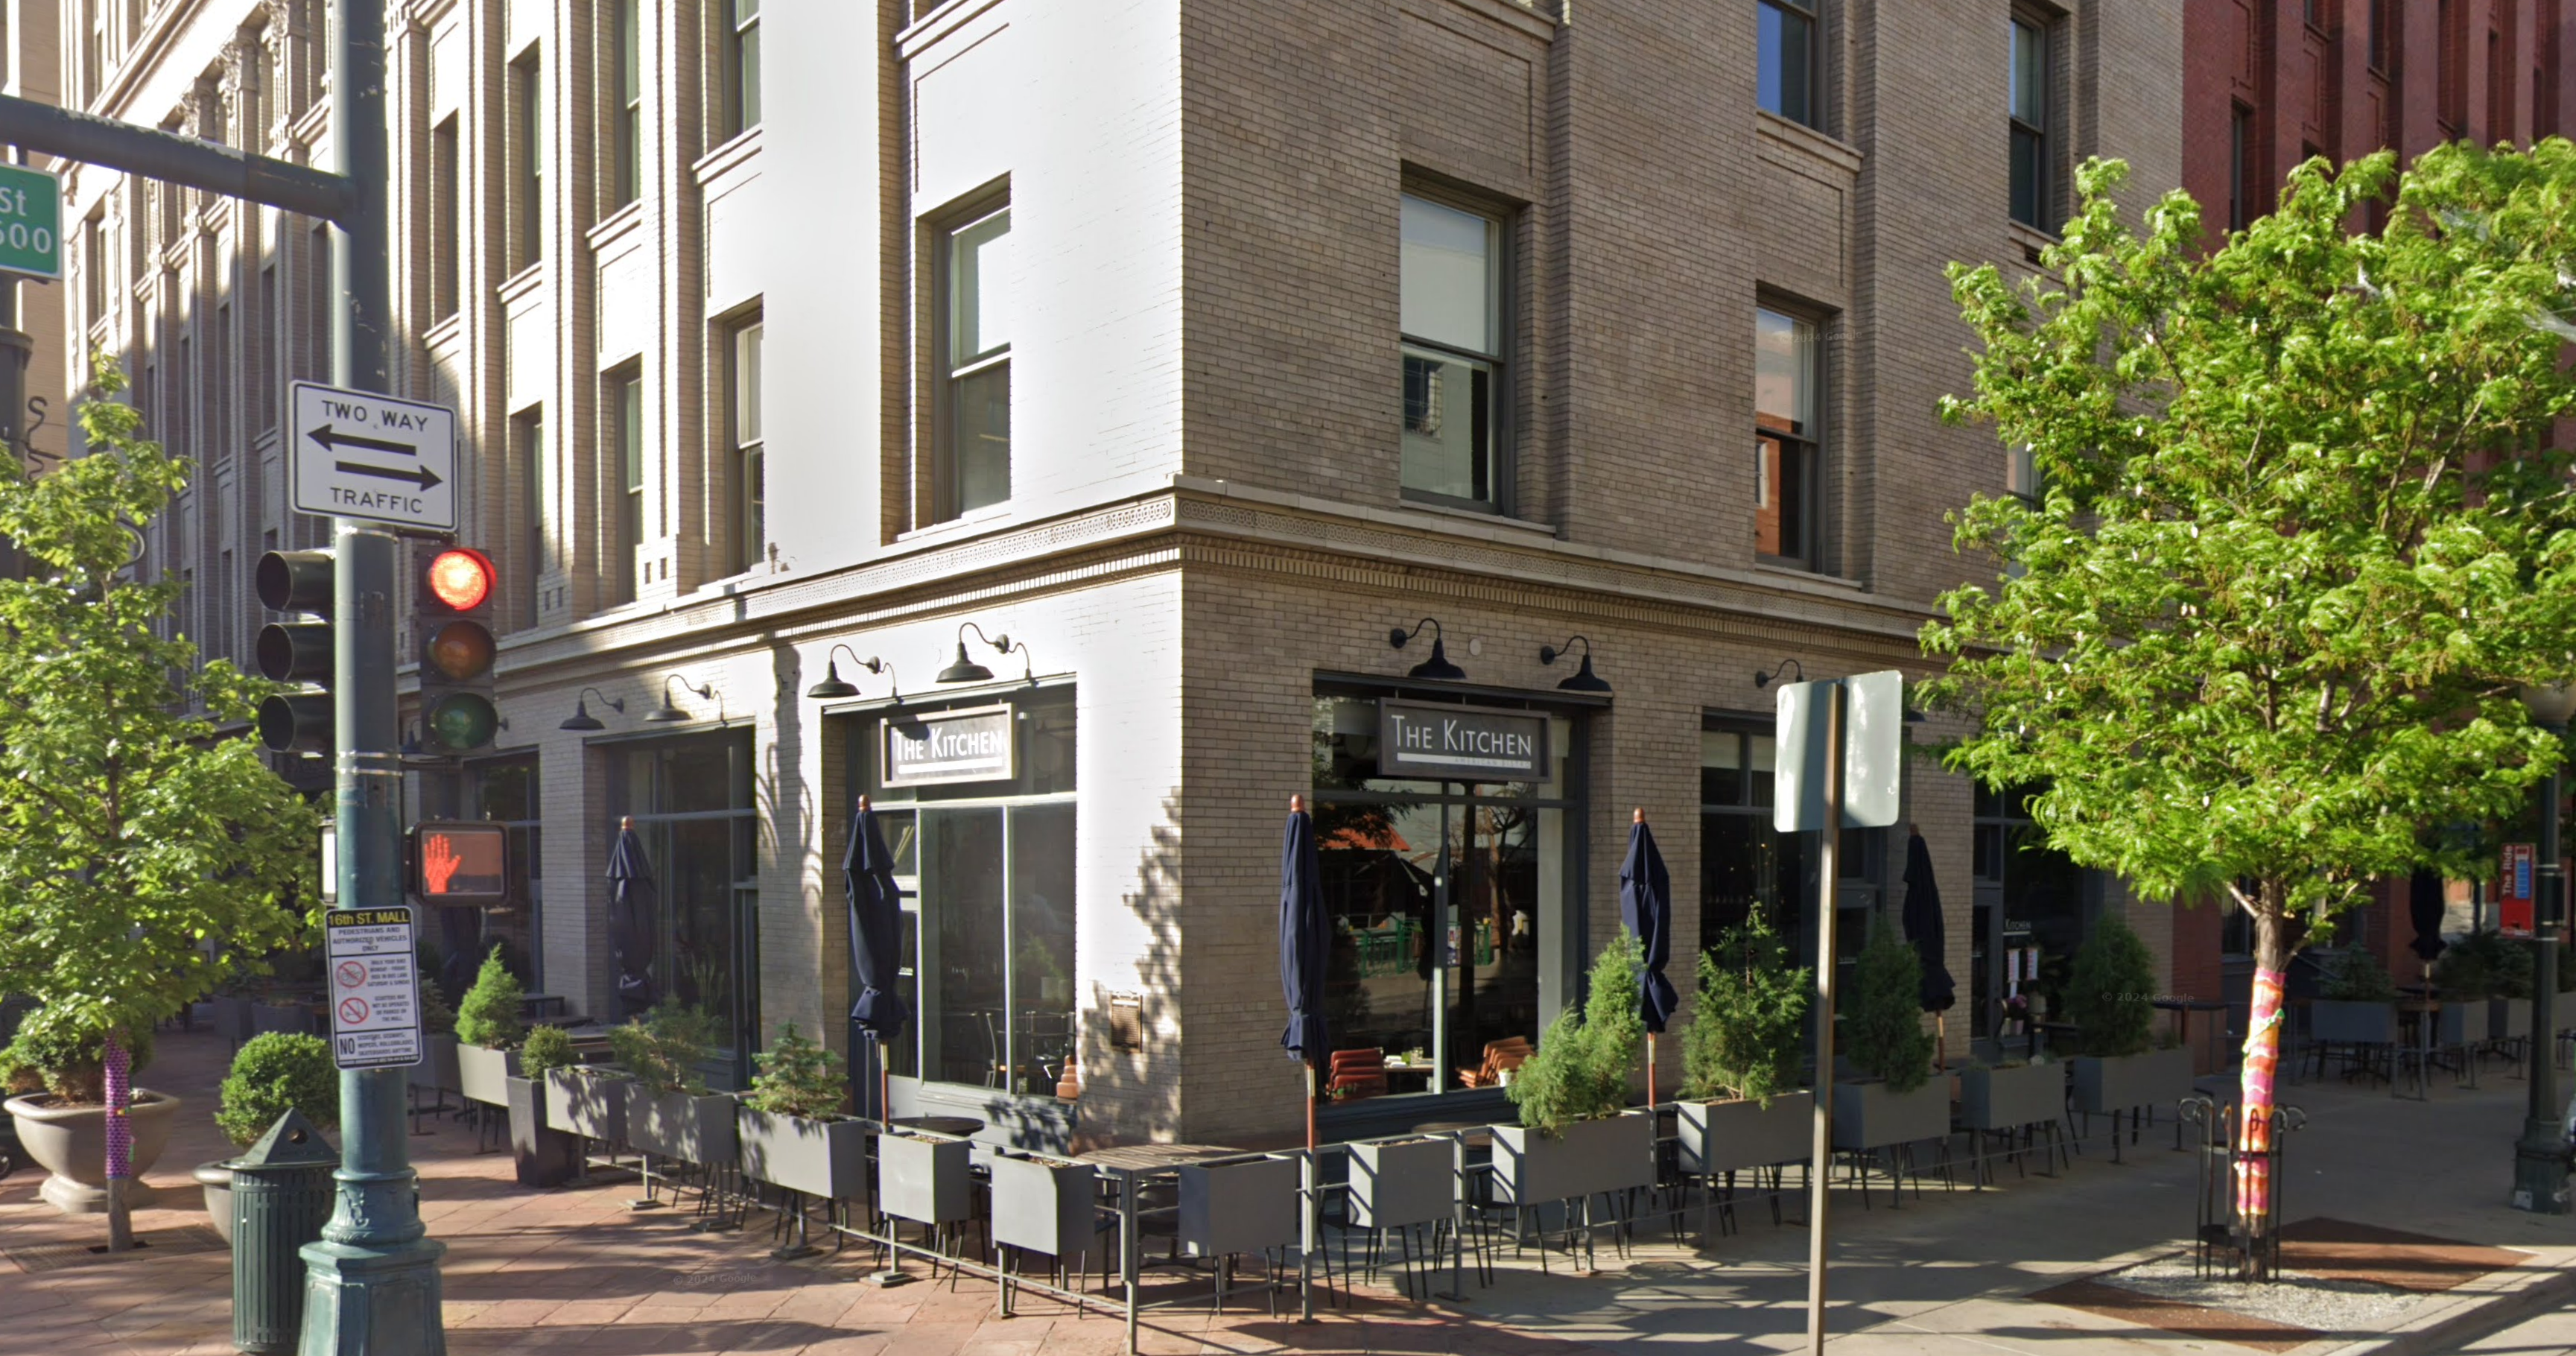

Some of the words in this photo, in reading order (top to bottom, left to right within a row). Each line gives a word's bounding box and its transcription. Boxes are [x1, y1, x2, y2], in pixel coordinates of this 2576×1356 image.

[0, 186, 27, 216] St
[322, 400, 367, 422] TWO
[381, 410, 428, 431] WAY
[330, 487, 422, 513] TRAFFIC
[894, 731, 924, 761] THE
[930, 726, 1003, 758] KITCHEN
[1390, 714, 1433, 750] THE
[1443, 718, 1532, 756] KITCHEN
[2502, 845, 2513, 870] Ride
[2502, 875, 2512, 896] The
[329, 914, 354, 925] 16th
[357, 913, 374, 924] ST.
[377, 911, 410, 922] MALL
[340, 1038, 355, 1054] NO
